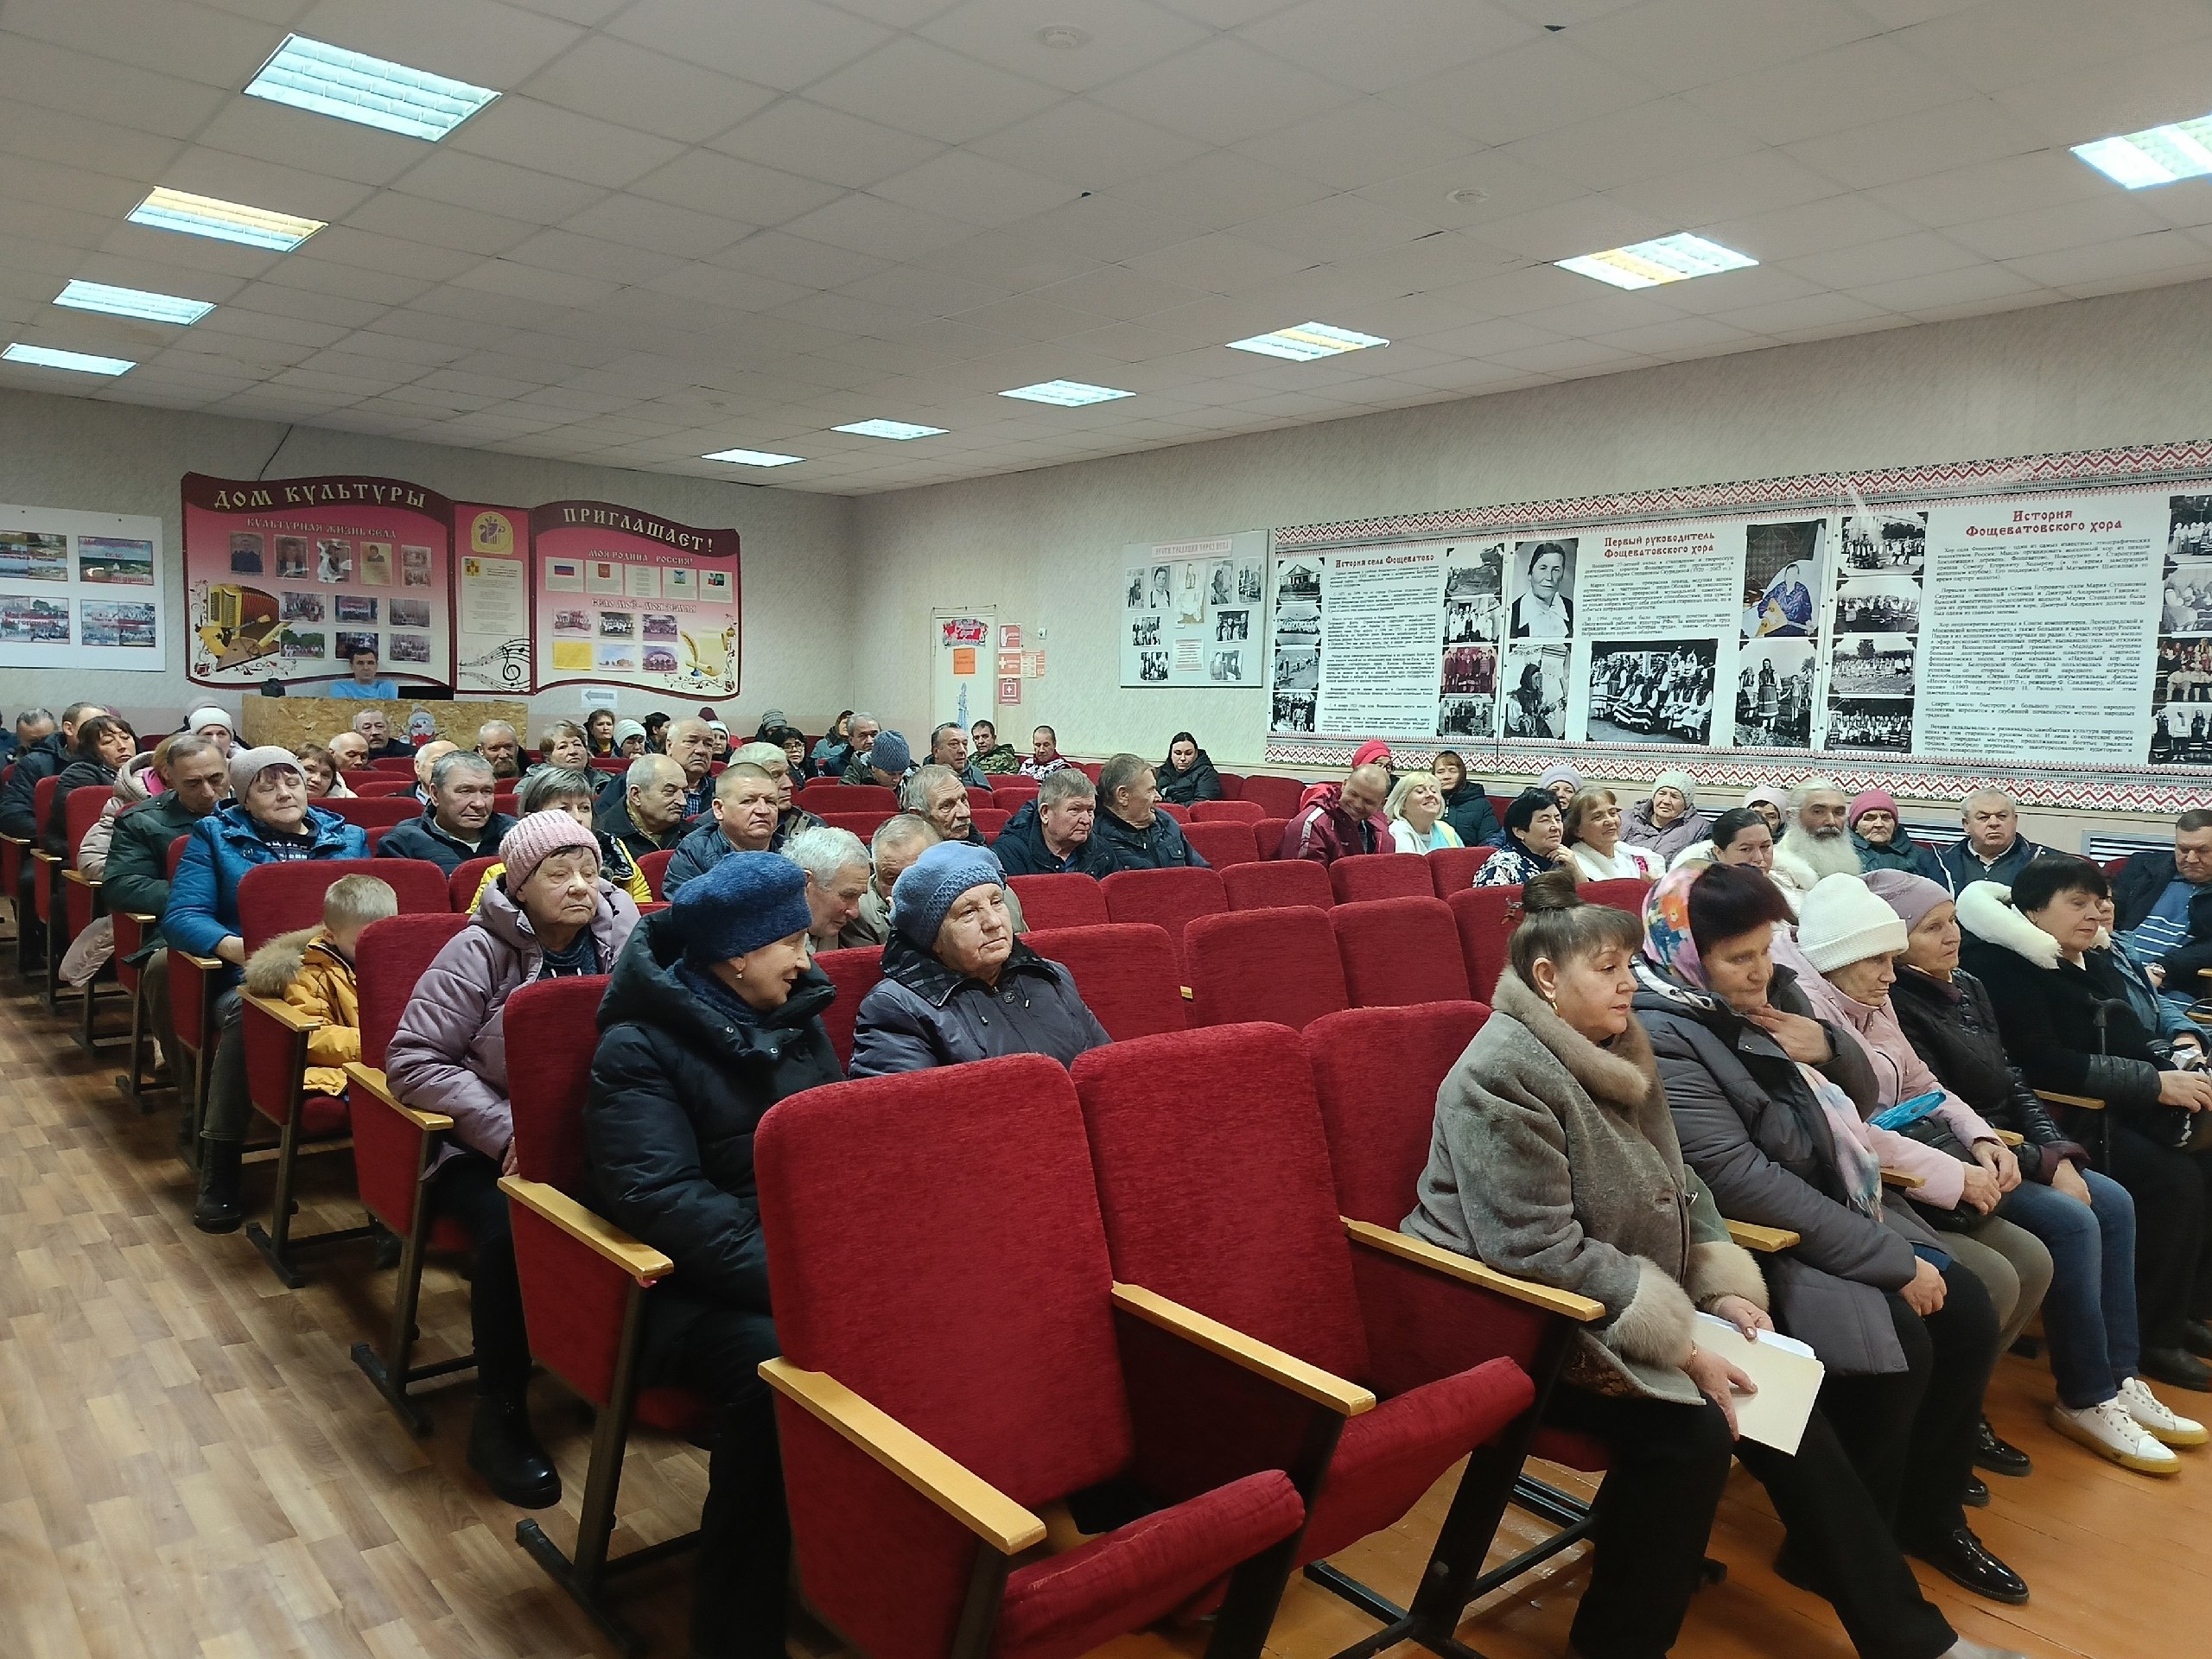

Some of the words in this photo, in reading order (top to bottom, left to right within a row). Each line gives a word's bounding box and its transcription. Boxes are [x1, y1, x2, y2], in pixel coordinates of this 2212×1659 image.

[214, 489, 274, 510] ДОМ
[284, 484, 426, 509] КУЛЬТУРЫ
[2012, 510, 2073, 523] История
[246, 518, 322, 532] КУЛЬТУРНАЯ
[326, 524, 365, 537] ЖИЗНЬ
[563, 507, 713, 553] ПРИГЛАШАЕТ!
[1966, 520, 2085, 537] Фощеватовского
[2089, 519, 2122, 533] хора
[1605, 537, 1642, 549] Первый
[1644, 531, 1715, 546] руководитель
[1605, 545, 1688, 559] Фощеватовского
[1691, 543, 1713, 555] хора
[1336, 559, 1365, 569] История
[1386, 554, 1434, 565] Фощеватово
